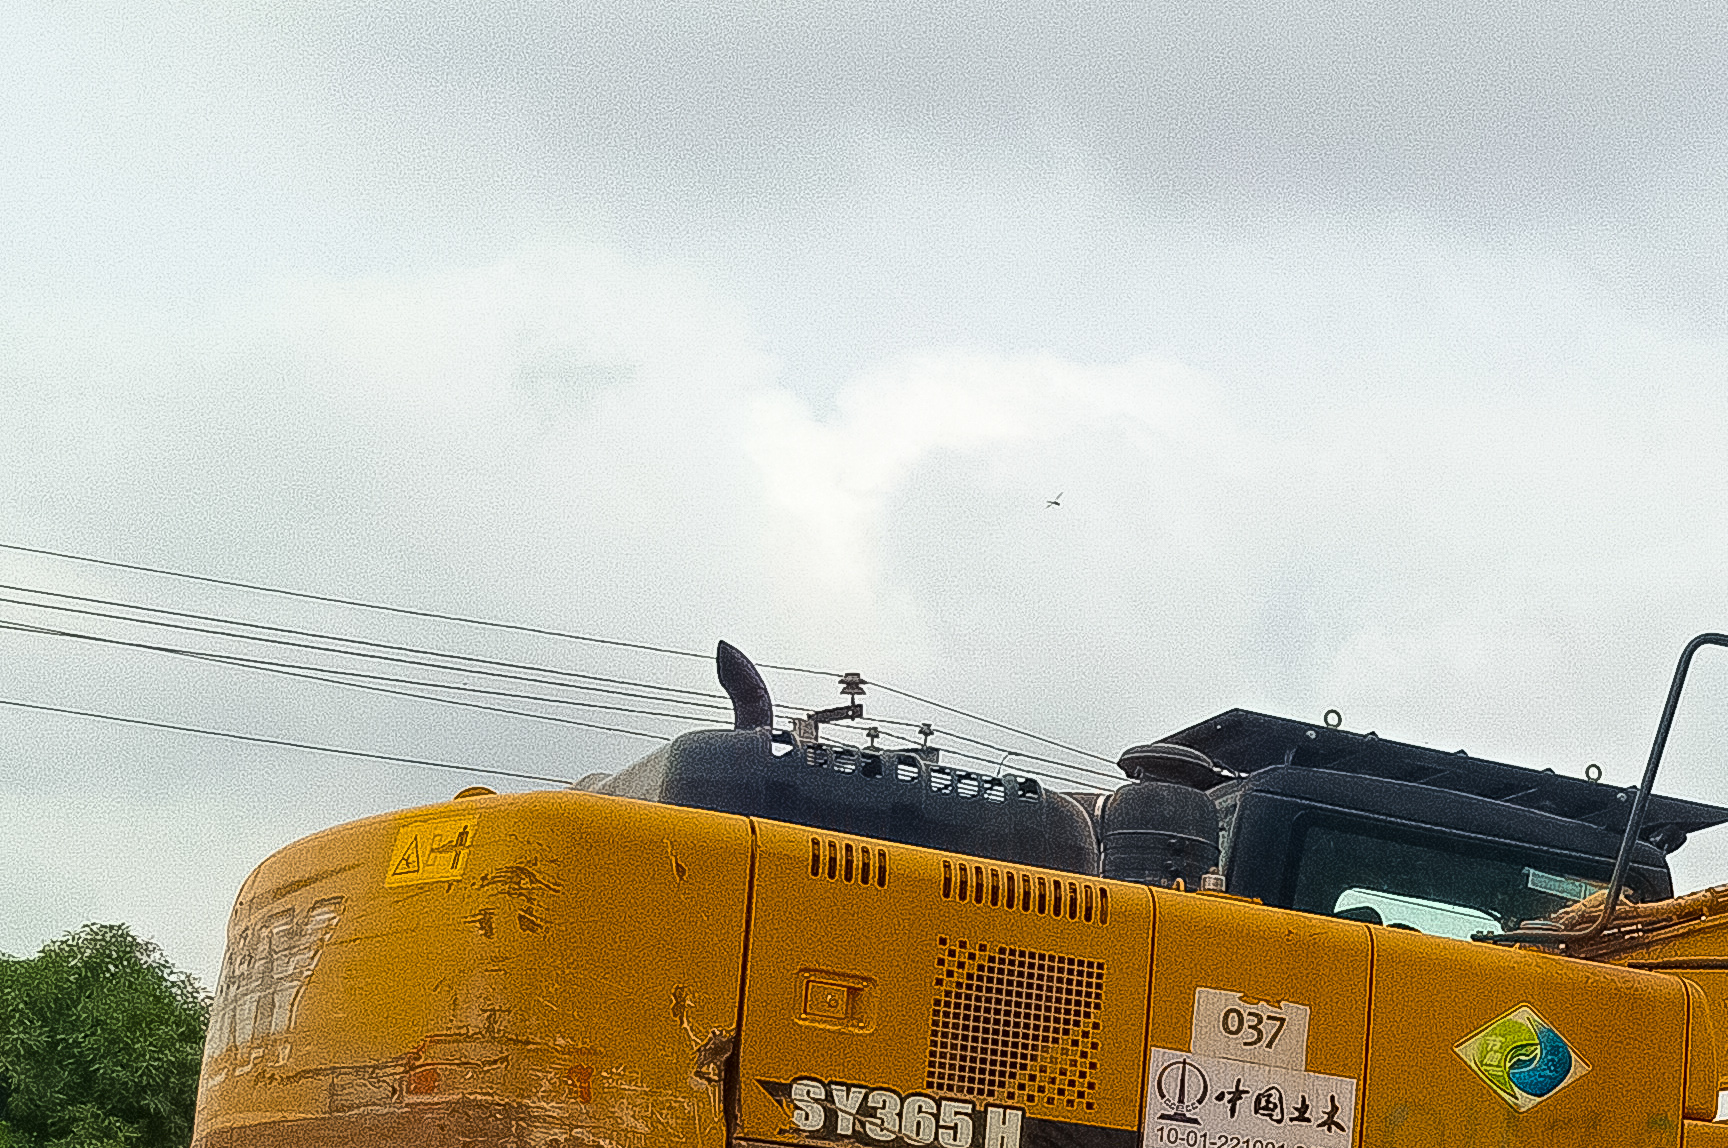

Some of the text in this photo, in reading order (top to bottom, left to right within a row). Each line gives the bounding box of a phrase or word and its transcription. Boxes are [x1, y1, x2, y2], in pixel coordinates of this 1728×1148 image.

[1221, 1007, 1287, 1049] 037
[1214, 1077, 1347, 1133] 中国土木
